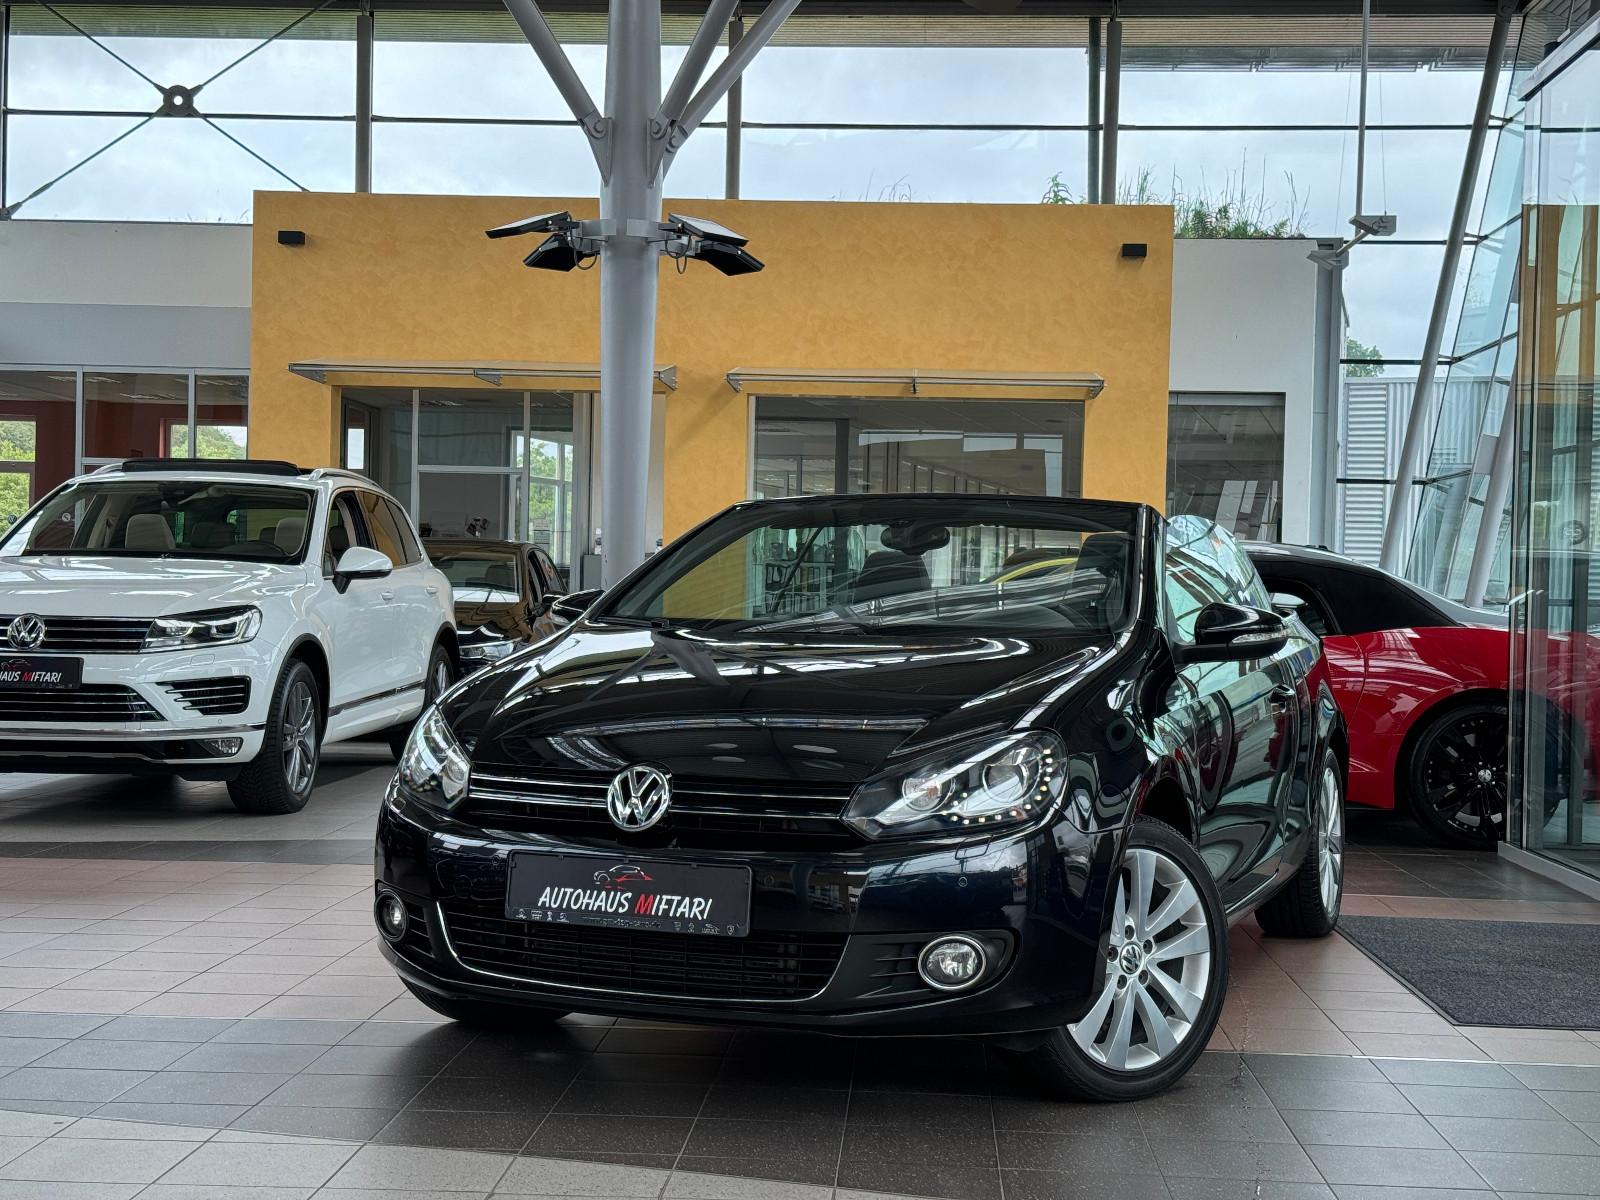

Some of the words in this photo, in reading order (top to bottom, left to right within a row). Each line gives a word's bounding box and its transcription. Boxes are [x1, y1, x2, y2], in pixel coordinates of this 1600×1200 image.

[22, 671, 62, 683] MIFTARI
[608, 766, 669, 832] VW
[537, 886, 633, 915] AUTOHAUS
[634, 892, 713, 921] MIFTARI
